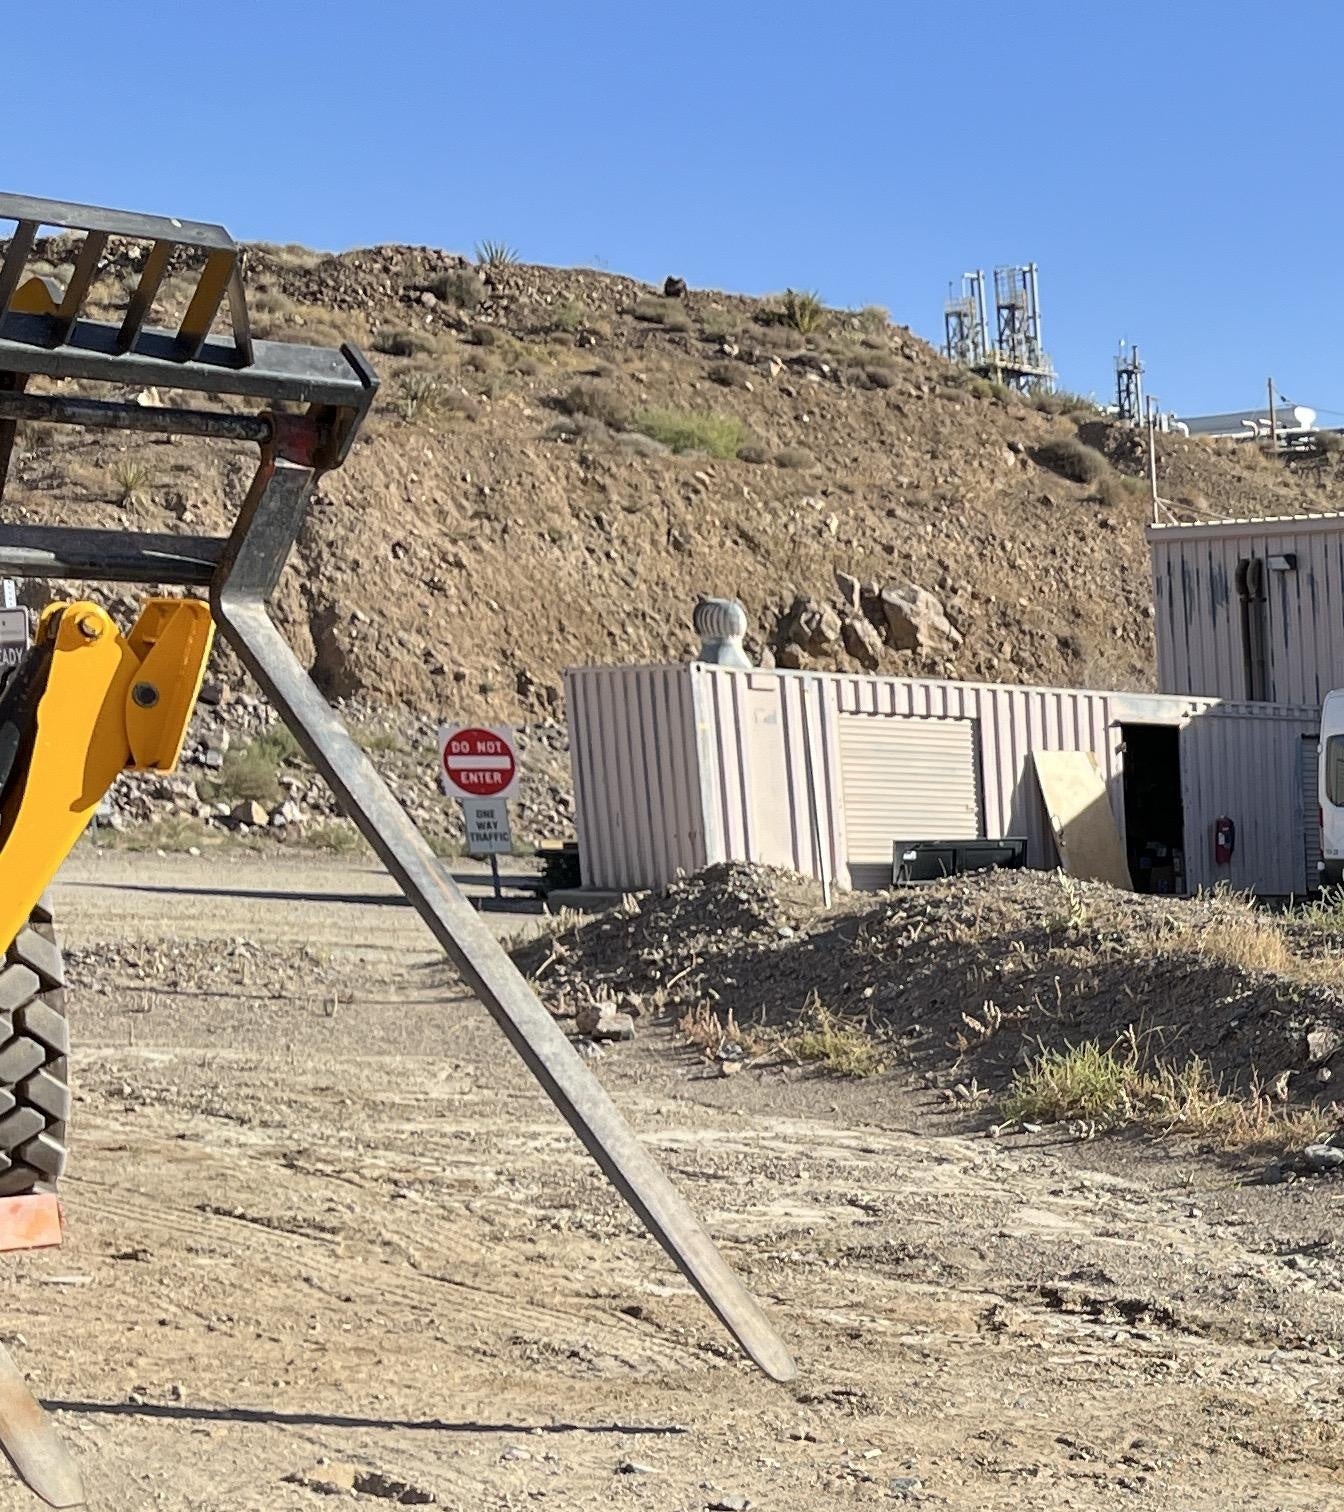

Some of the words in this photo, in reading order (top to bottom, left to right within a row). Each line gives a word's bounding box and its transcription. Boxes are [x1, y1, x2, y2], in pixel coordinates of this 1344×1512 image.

[451, 741, 470, 754] DO
[476, 741, 502, 754] NOT
[460, 771, 502, 784] ENTER
[476, 809, 495, 819] ONE
[476, 820, 498, 830] WAY
[470, 831, 509, 842] TRAFFIC
